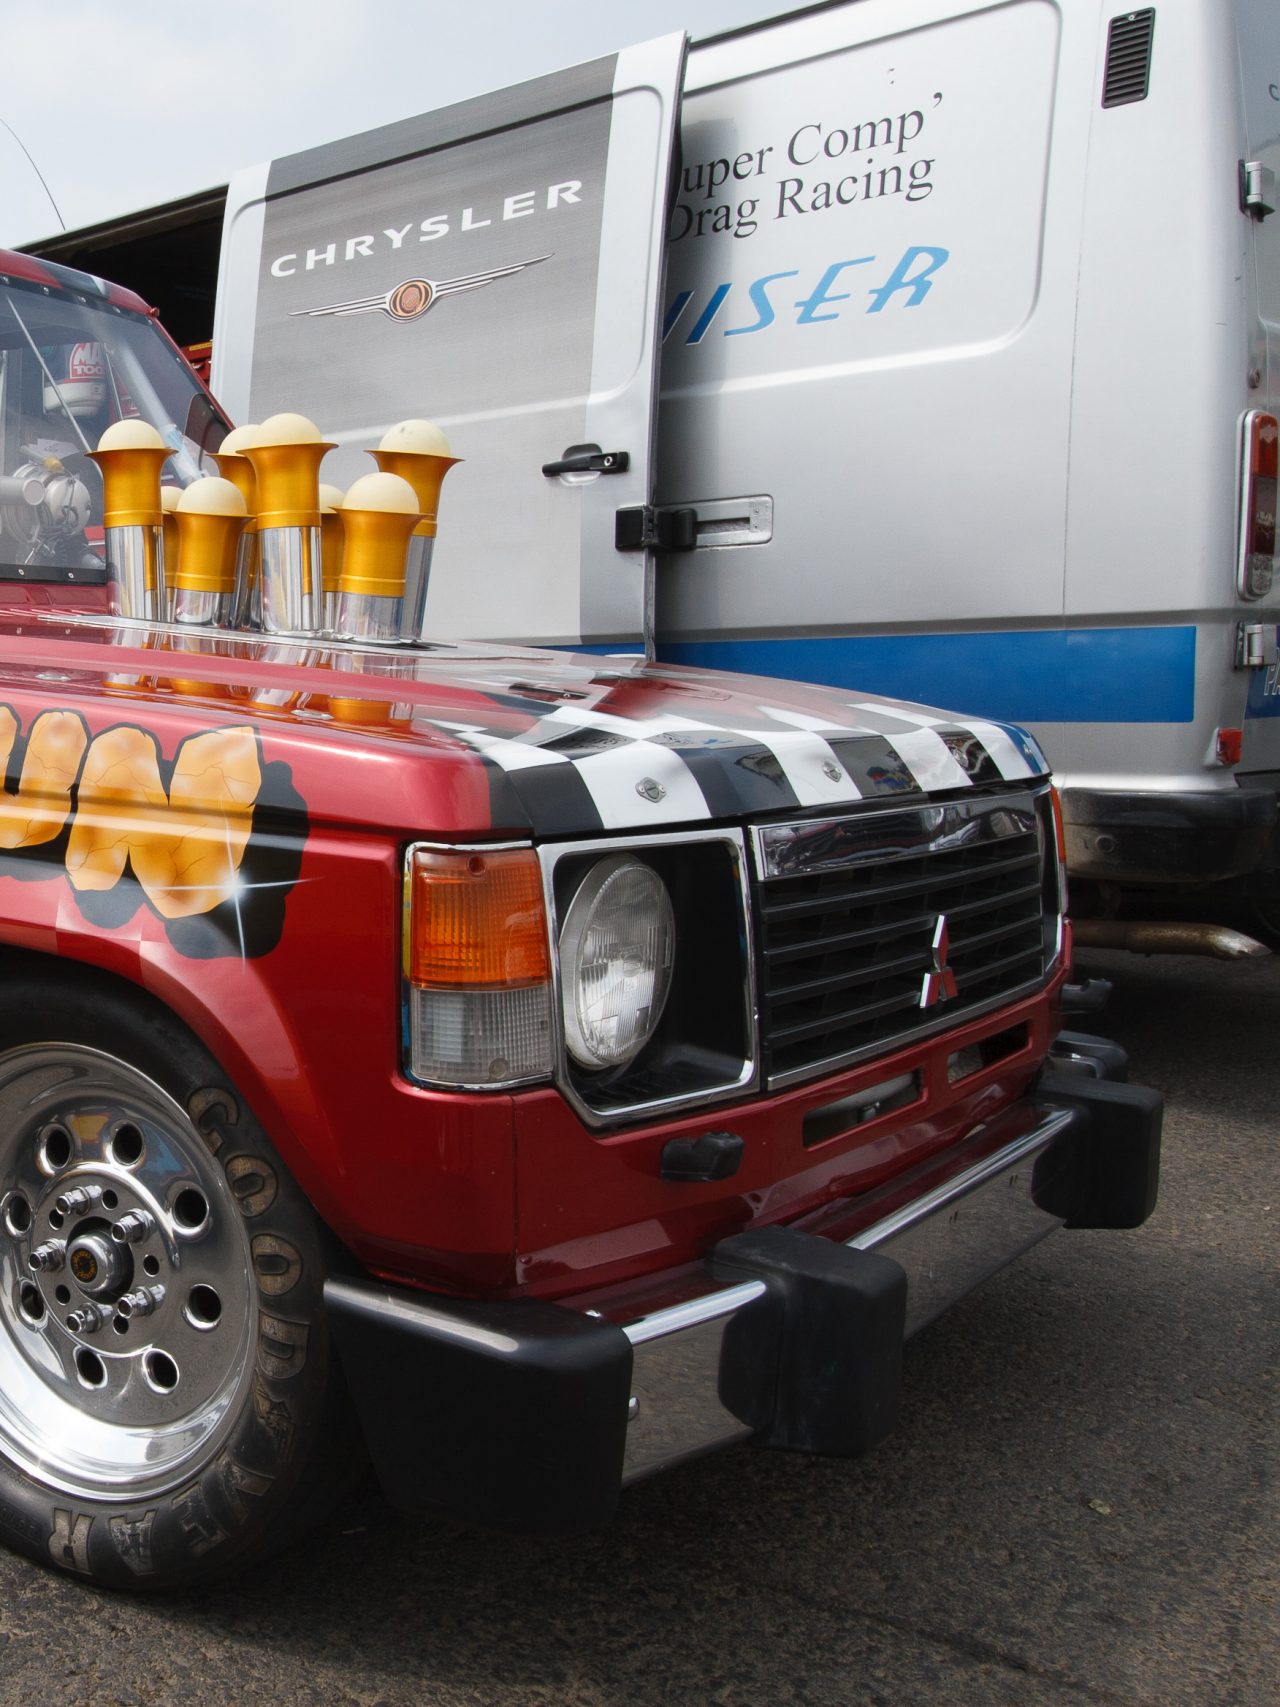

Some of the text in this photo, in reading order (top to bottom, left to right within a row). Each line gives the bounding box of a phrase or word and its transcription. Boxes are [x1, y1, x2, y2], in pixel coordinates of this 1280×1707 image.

[682, 146, 774, 200] uper
[773, 157, 936, 220] Racing
[270, 179, 583, 278] CHRYSLER
[73, 342, 106, 365] MA
[48, 1086, 312, 1578] GOODYEAR
